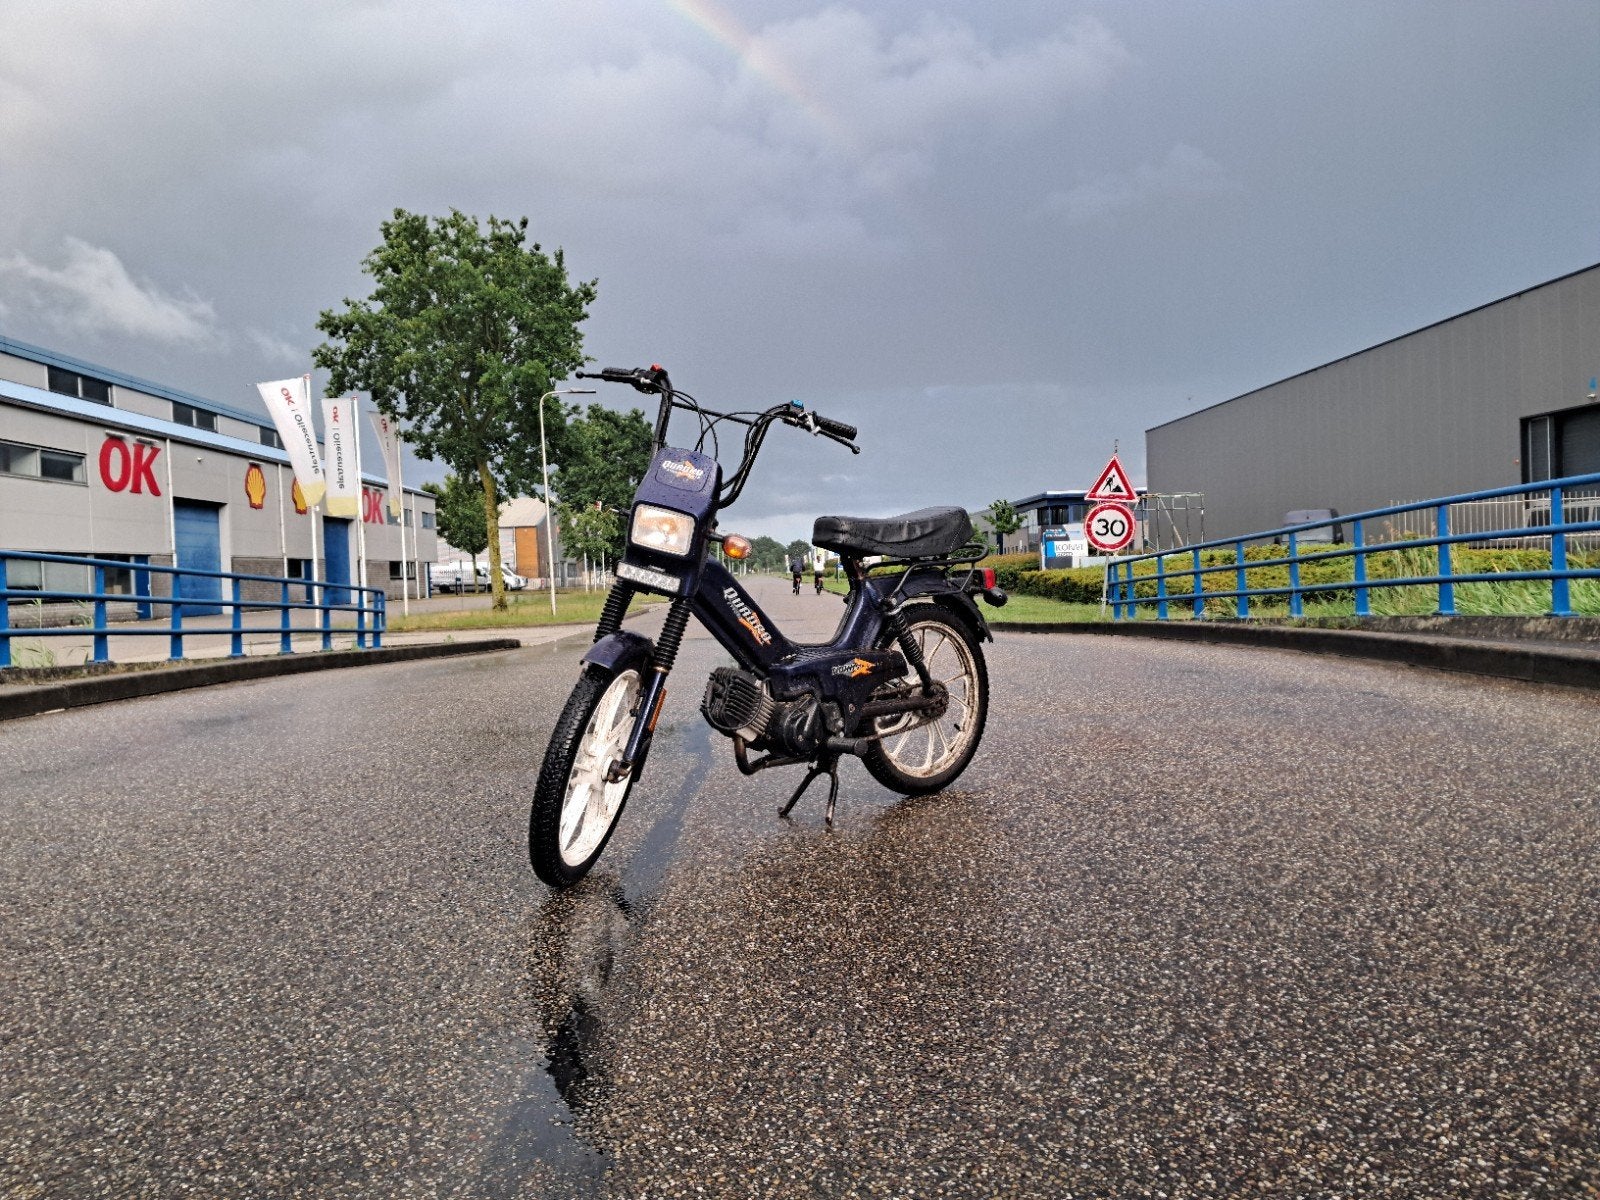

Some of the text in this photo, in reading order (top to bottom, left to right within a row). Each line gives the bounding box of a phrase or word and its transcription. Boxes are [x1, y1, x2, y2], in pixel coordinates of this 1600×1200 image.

[281, 387, 295, 406] OK
[99, 436, 162, 497] OK
[362, 488, 384, 525] OK
[1095, 518, 1126, 537] 30
